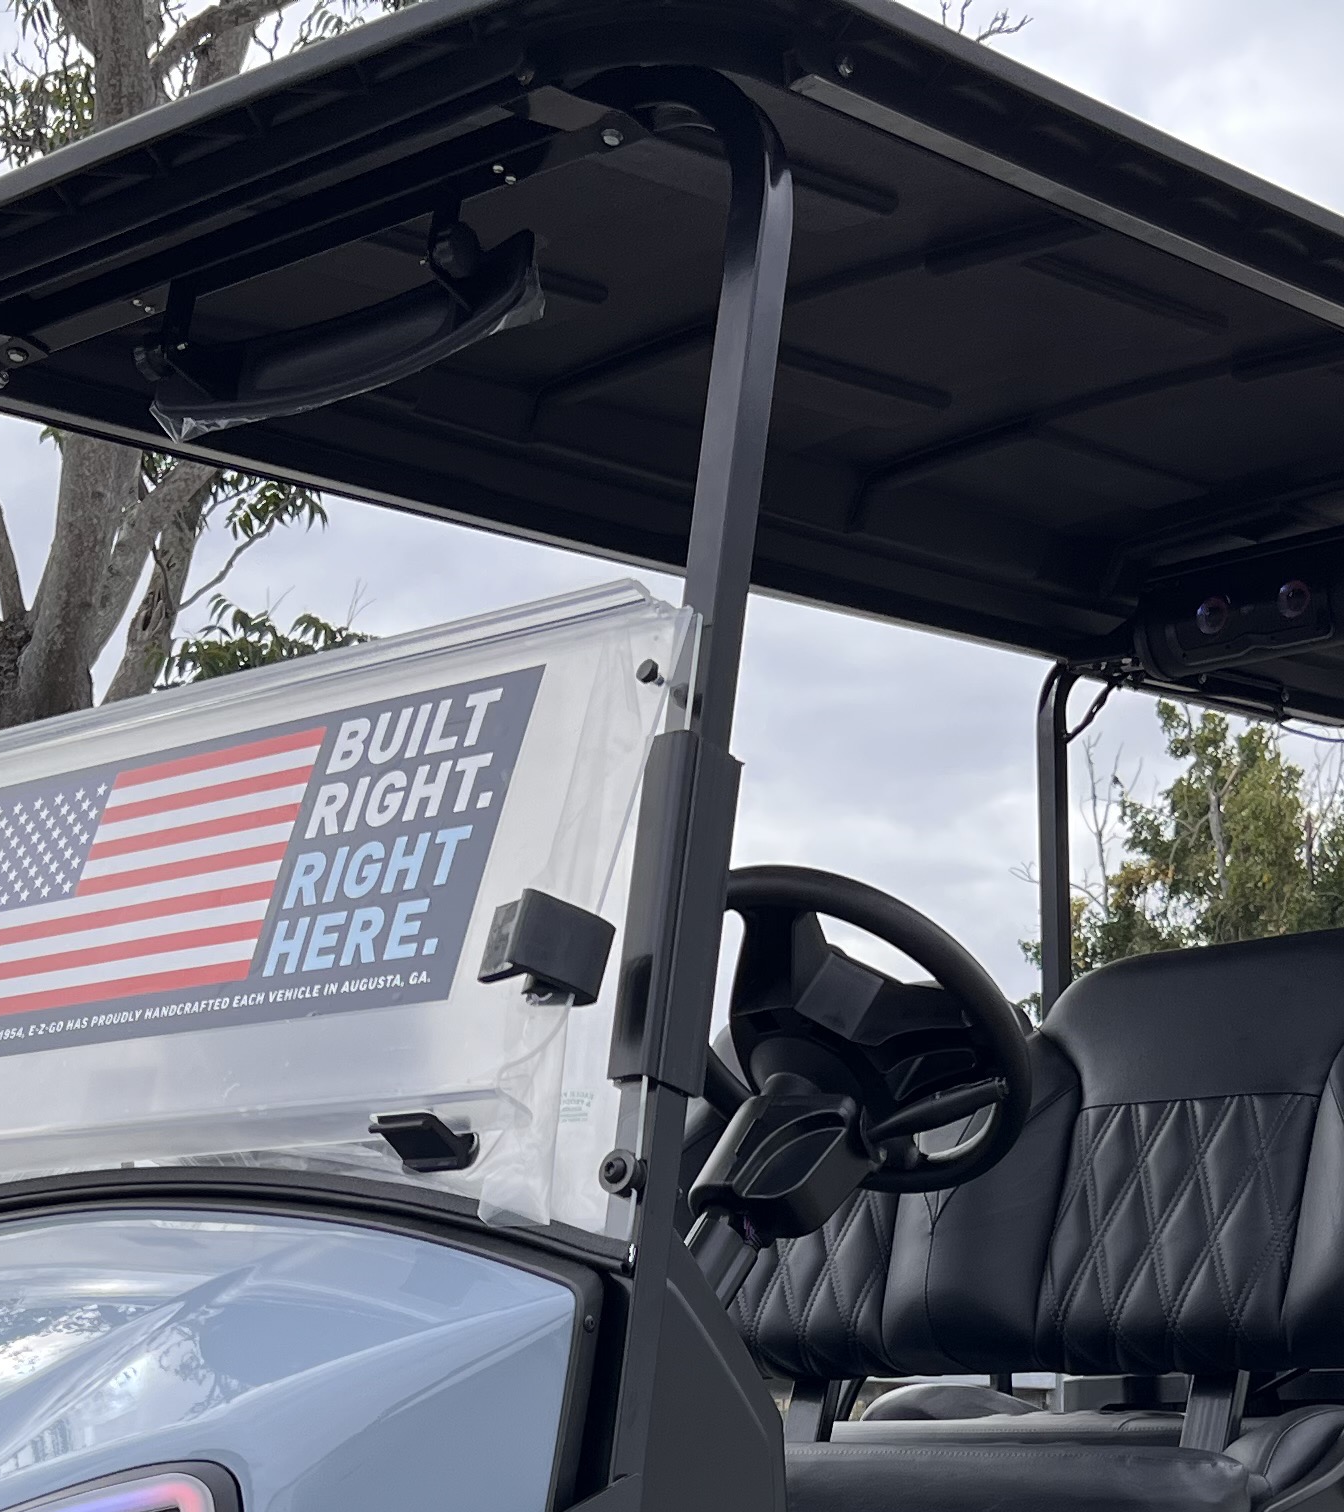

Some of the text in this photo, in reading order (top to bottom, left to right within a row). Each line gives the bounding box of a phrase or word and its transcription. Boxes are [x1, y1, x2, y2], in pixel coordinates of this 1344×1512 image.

[325, 687, 504, 775] BUILT
[304, 752, 494, 840] RIGHT.
[282, 824, 474, 910] RIGHT
[262, 897, 439, 978] HERE.
[66, 1017, 88, 1031] HAS
[91, 1009, 142, 1029] PROUDLY
[144, 996, 230, 1020] HANDCRAFTED
[232, 992, 264, 1008] EACH
[268, 984, 321, 1004] VEHICLE
[323, 982, 339, 996] IN
[341, 973, 405, 994] AUGUSTA,
[408, 970, 432, 986] GA.
